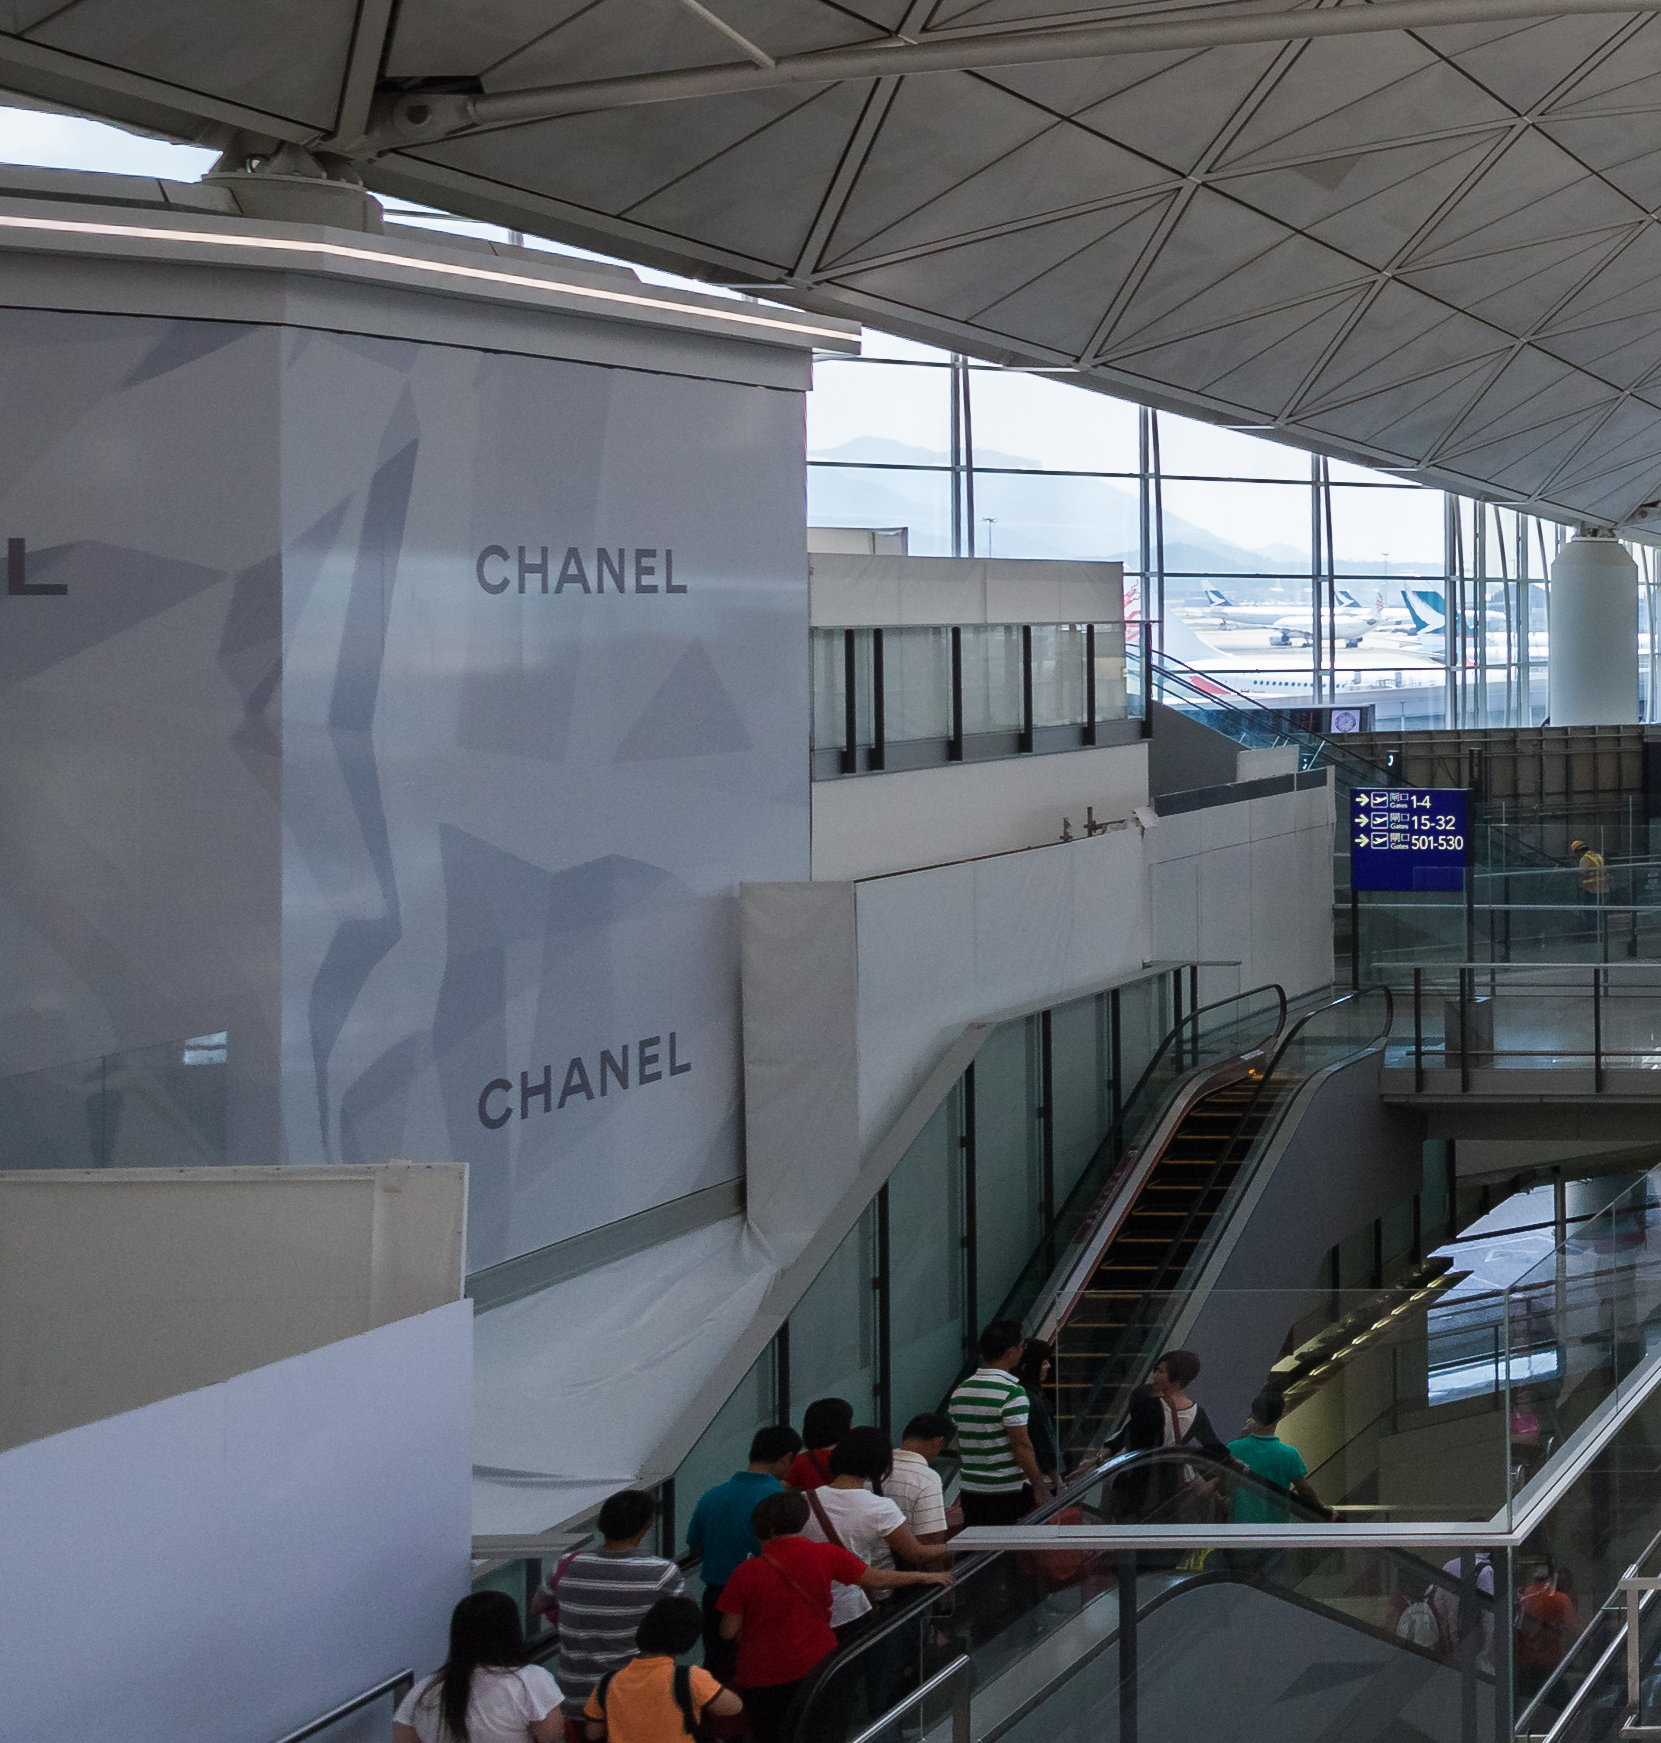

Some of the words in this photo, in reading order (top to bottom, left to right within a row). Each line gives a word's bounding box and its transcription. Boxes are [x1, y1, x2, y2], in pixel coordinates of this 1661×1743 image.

[476, 544, 688, 595] CHANEL
[1411, 796, 1431, 808] 1-4
[1411, 816, 1455, 829] 15-32
[1411, 836, 1464, 850] 501-530
[477, 1032, 692, 1130] CHANEL
